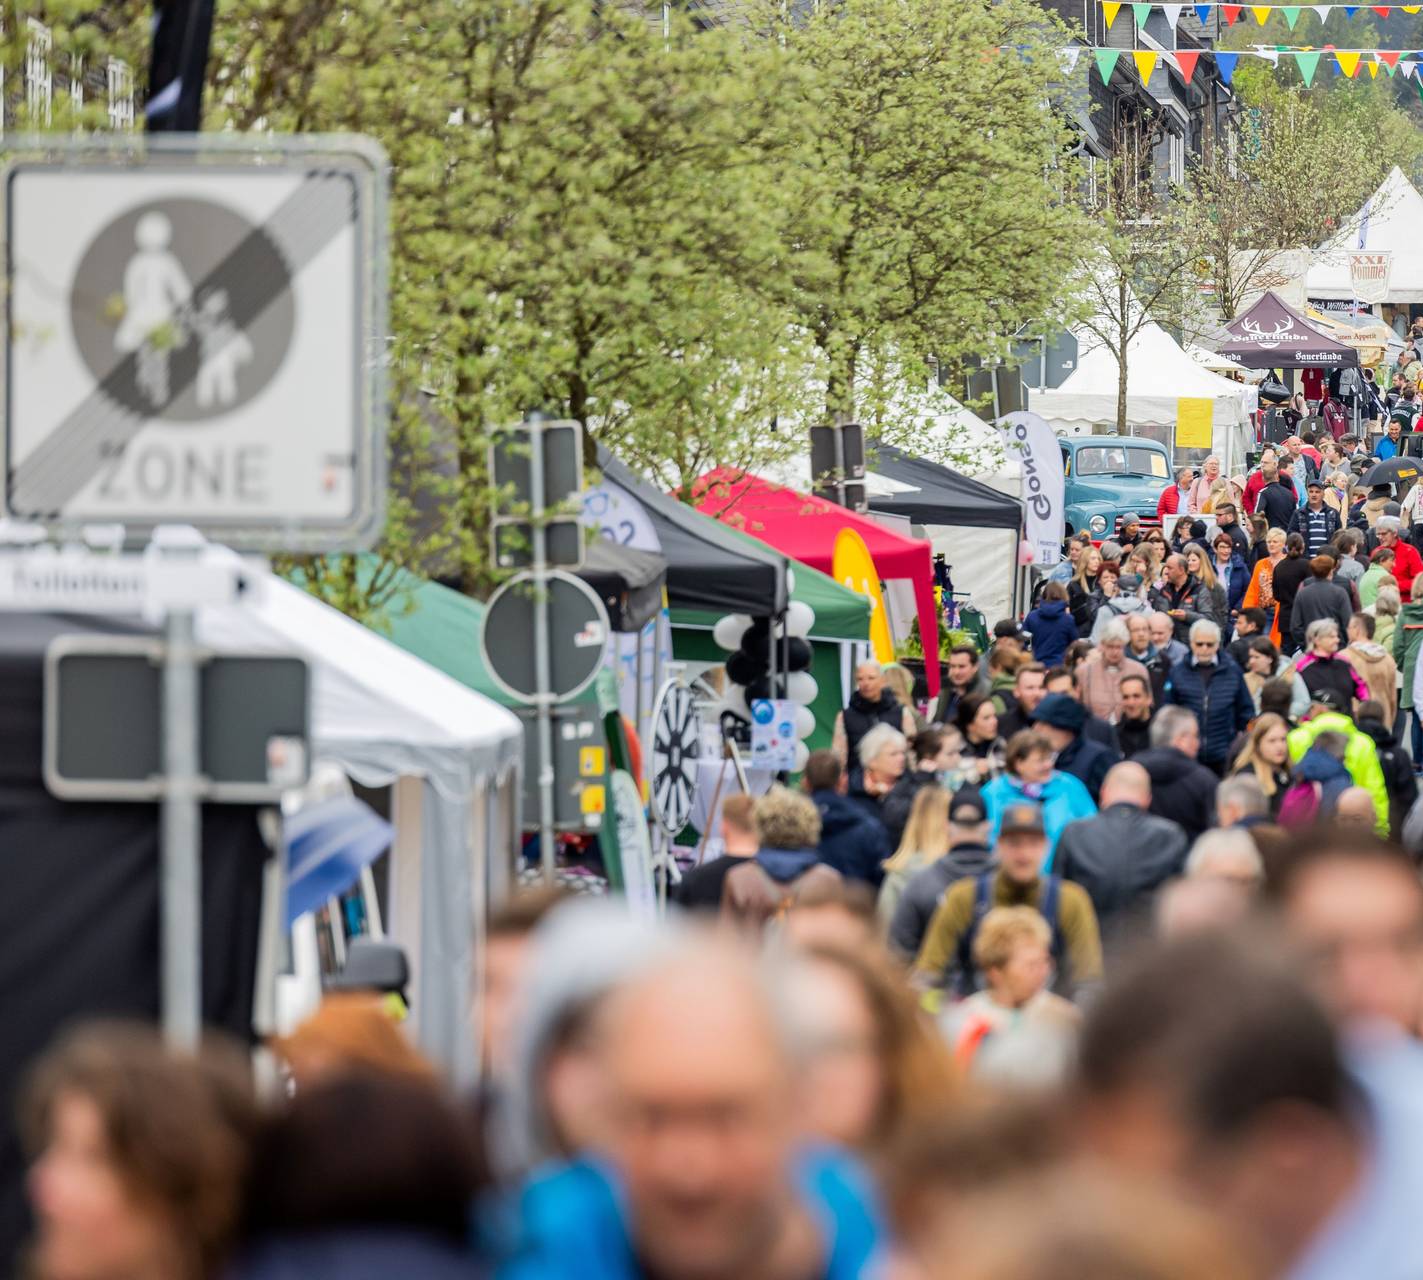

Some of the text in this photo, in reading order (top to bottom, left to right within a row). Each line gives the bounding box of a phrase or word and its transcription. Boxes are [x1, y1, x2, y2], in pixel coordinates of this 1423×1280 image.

[1351, 255, 1386, 265] XXL
[1350, 264, 1386, 281] Pommes
[1354, 333, 1377, 341] Appetit
[1295, 351, 1342, 361] Sauerlända
[97, 441, 269, 500] ZONE
